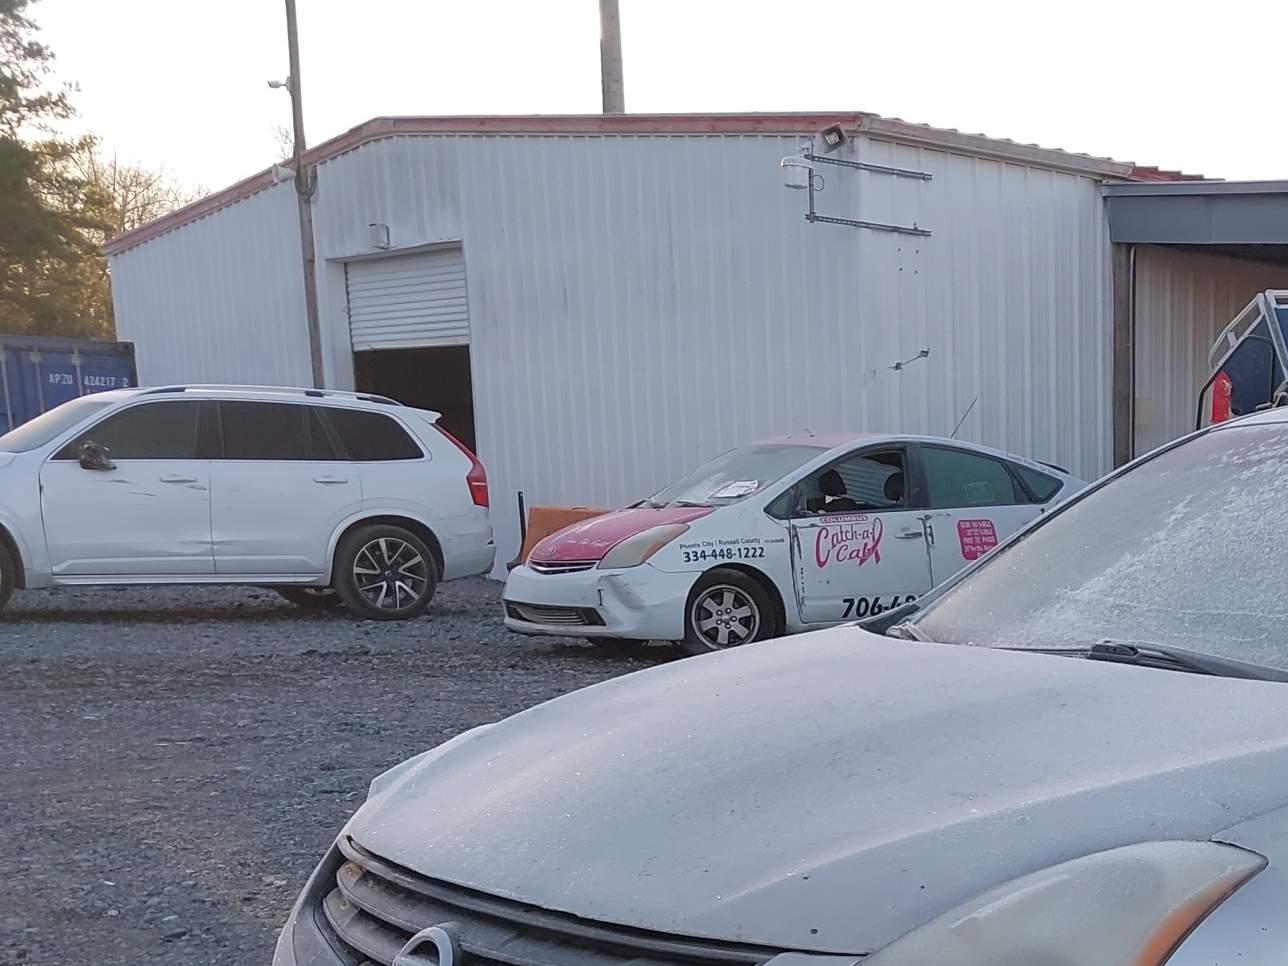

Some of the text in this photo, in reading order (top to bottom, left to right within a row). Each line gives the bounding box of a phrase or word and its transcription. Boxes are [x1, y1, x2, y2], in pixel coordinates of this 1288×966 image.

[84, 376, 115, 386] 424217
[821, 515, 867, 523] COLUMBUS
[683, 546, 766, 563] 334-448-1222
